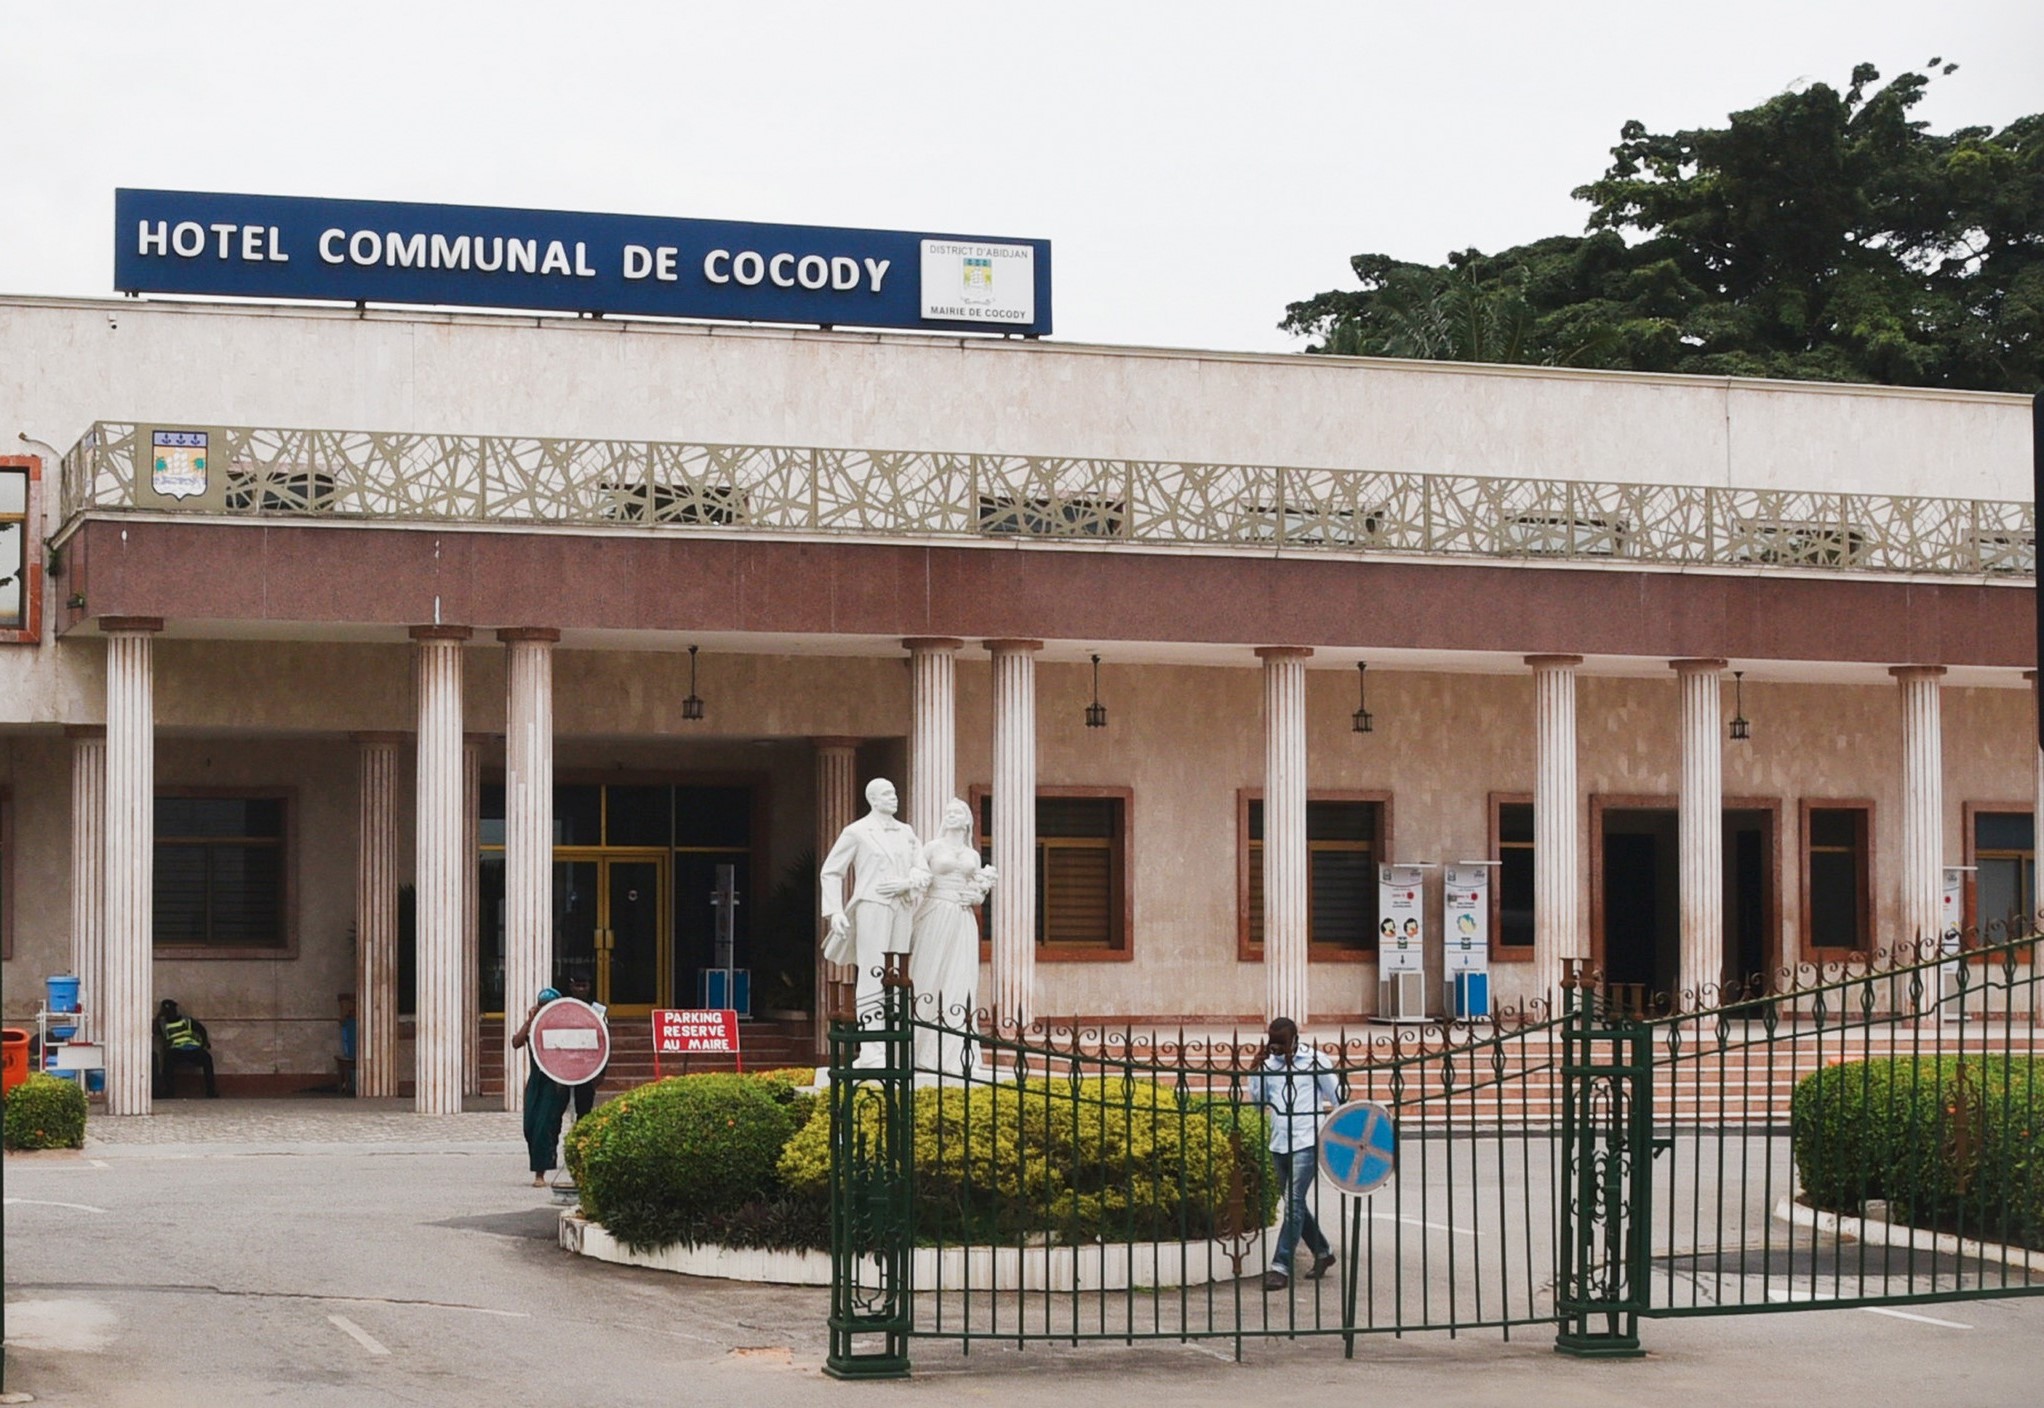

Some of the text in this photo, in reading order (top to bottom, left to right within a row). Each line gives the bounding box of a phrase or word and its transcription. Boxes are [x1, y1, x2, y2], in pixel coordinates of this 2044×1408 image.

[138, 220, 891, 293] HOTEL COMMUNAL DE COCODY
[930, 245, 1028, 259] DISTRICT D'ABIDJAN
[930, 306, 1026, 319] MAIRIE DE COCODY
[664, 1012, 723, 1024] PARKING
[663, 1025, 726, 1037] RESERVE
[663, 1038, 730, 1050] AU MAIRE
